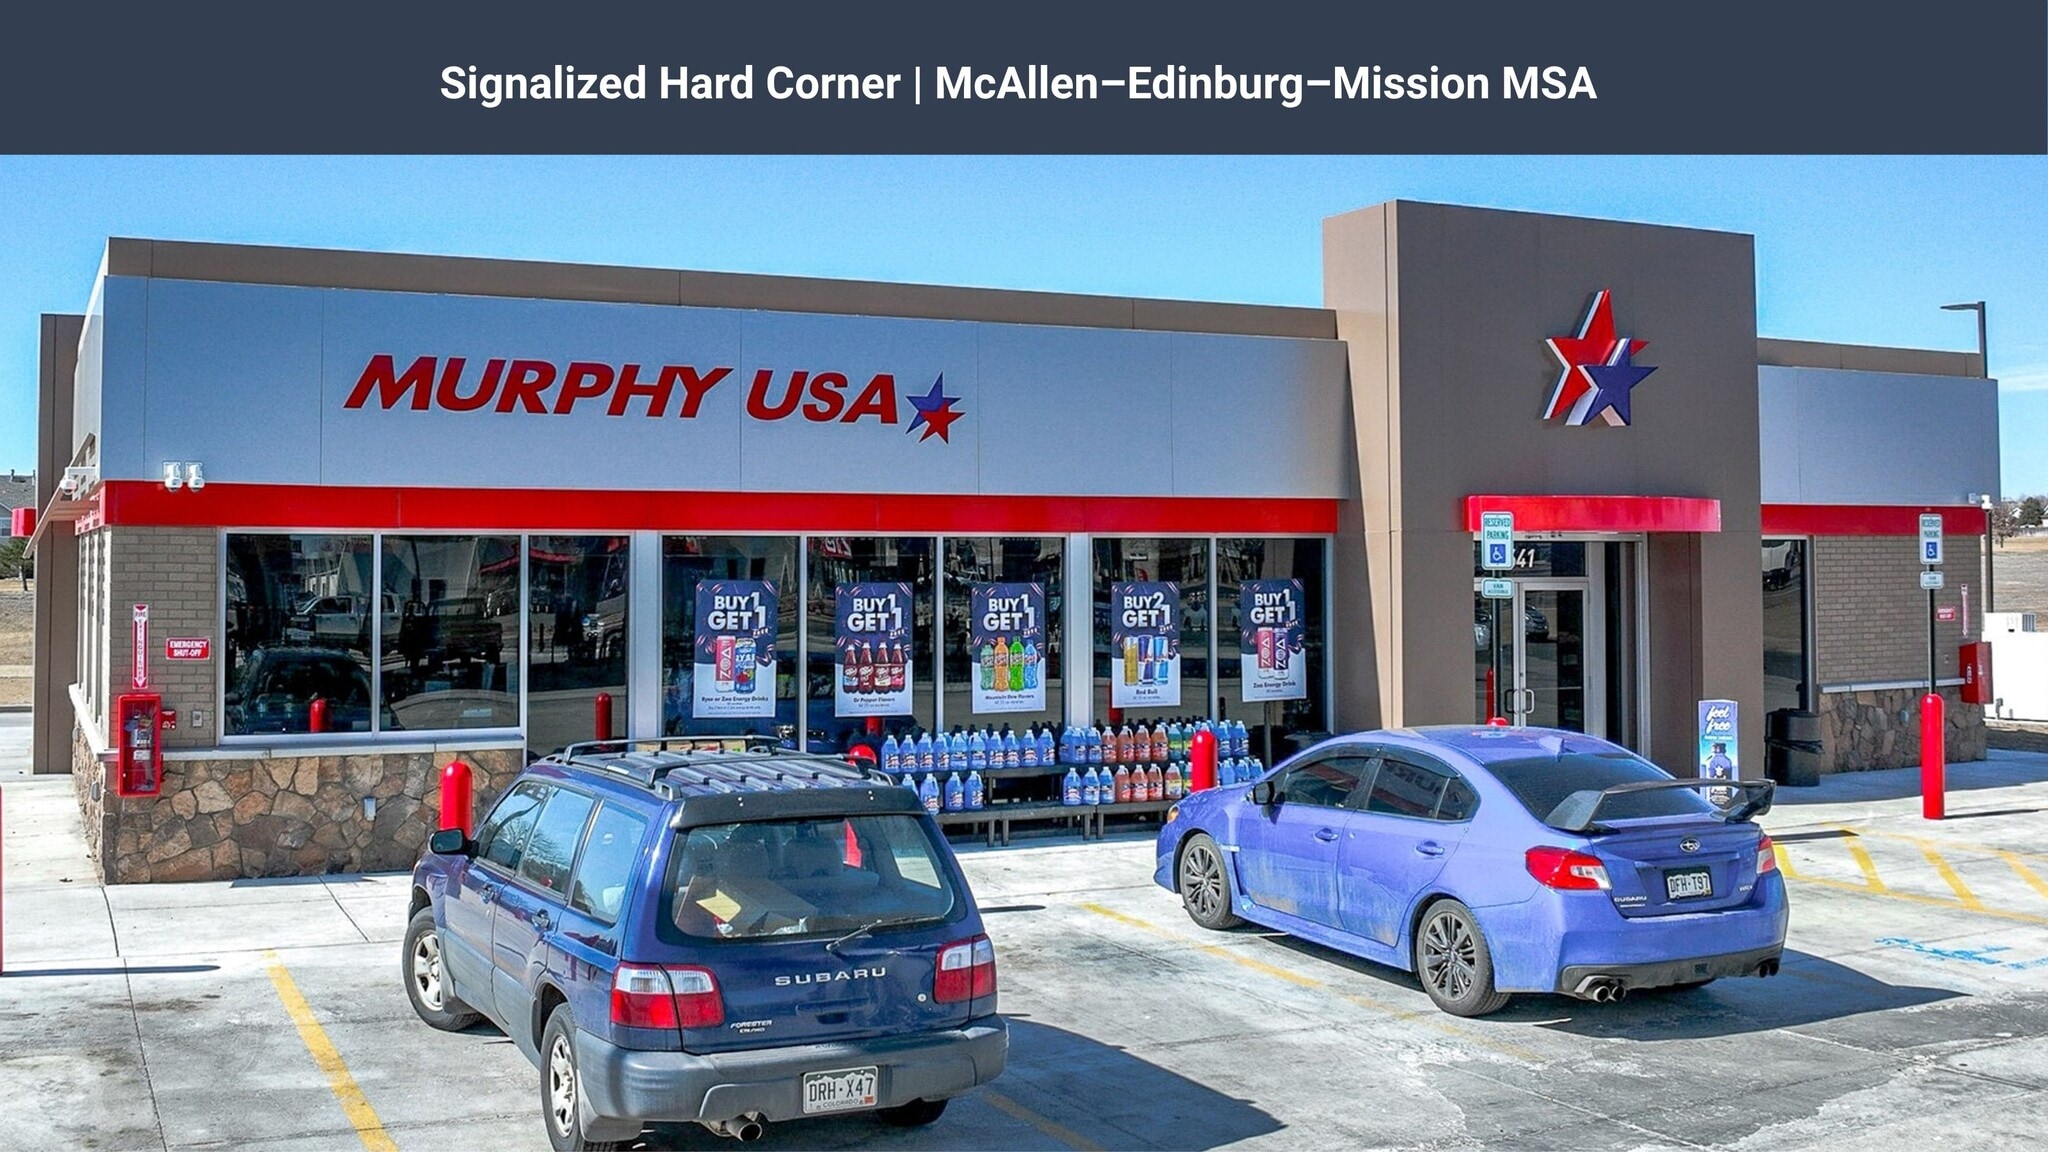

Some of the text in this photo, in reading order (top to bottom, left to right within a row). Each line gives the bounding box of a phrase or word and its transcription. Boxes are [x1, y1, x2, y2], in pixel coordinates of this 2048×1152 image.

[343, 353, 900, 425] MURPHY USA
[1487, 531, 1509, 540] PARKING
[1512, 548, 1535, 568] 41
[714, 591, 760, 610] BUY 1
[853, 593, 896, 612] BUY 1
[988, 593, 1029, 612] BUY 1
[1123, 591, 1164, 609] BUY 2
[1254, 588, 1291, 606] BUY 1
[707, 605, 766, 631] GET 1
[847, 607, 902, 632] GET 1
[983, 606, 1035, 631] GET 1
[1122, 604, 1171, 628] GET 1
[1250, 600, 1296, 624] GET 1
[170, 640, 208, 648] EMERGENCY
[1706, 705, 1730, 721] feel
[1706, 719, 1732, 734] free
[774, 967, 886, 986] SUBARU
[730, 1020, 772, 1029] FORESTER
[823, 1099, 858, 1108] COLORADO
